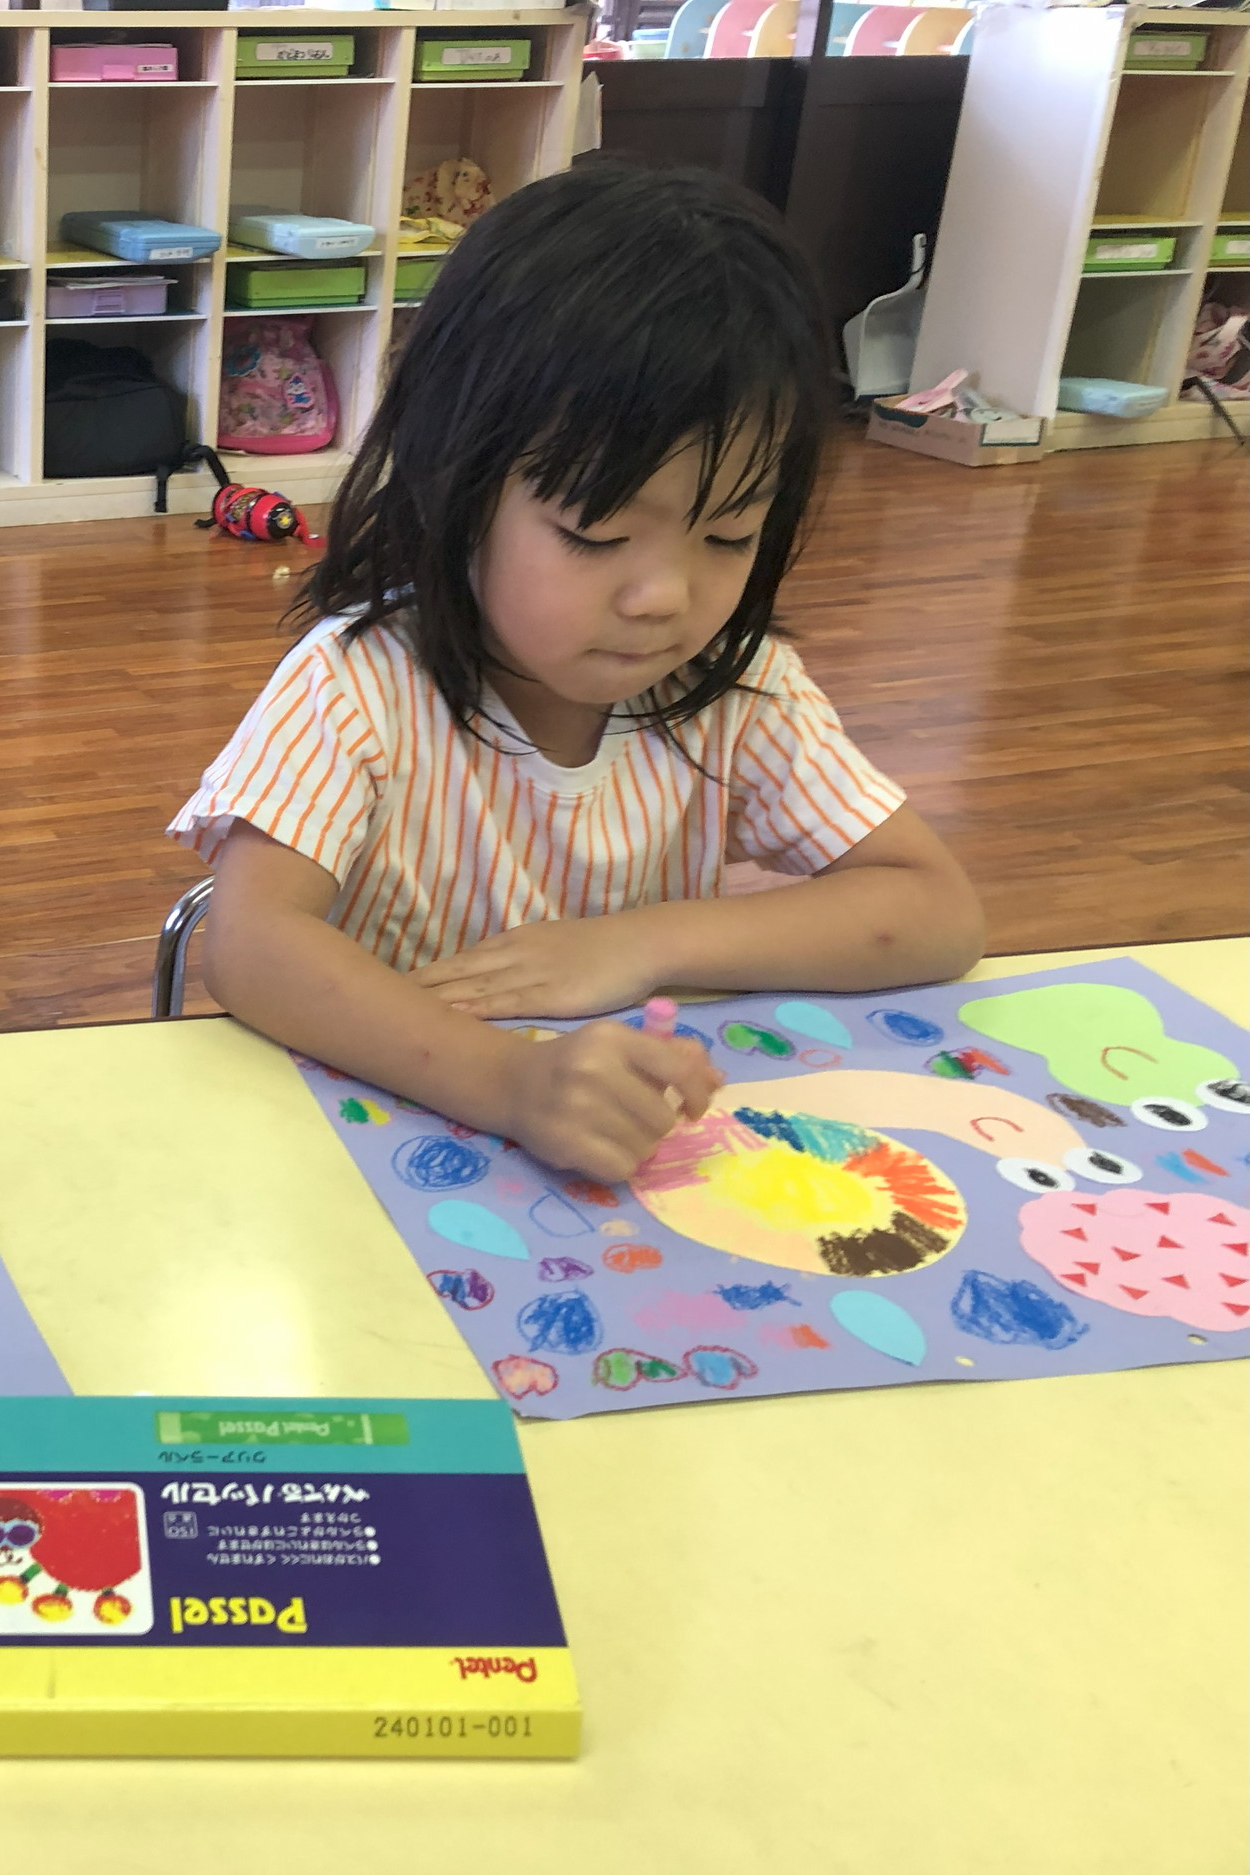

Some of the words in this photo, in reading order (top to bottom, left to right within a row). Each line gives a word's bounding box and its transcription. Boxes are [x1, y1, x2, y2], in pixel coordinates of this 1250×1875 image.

[218, 1421, 280, 1437] Passel
[158, 1450, 267, 1464] クリアーラベル
[160, 1482, 275, 1506] パッセル
[170, 1596, 308, 1634] Passel
[453, 1656, 538, 1683] Pentel
[373, 1715, 533, 1739] 240101-001
